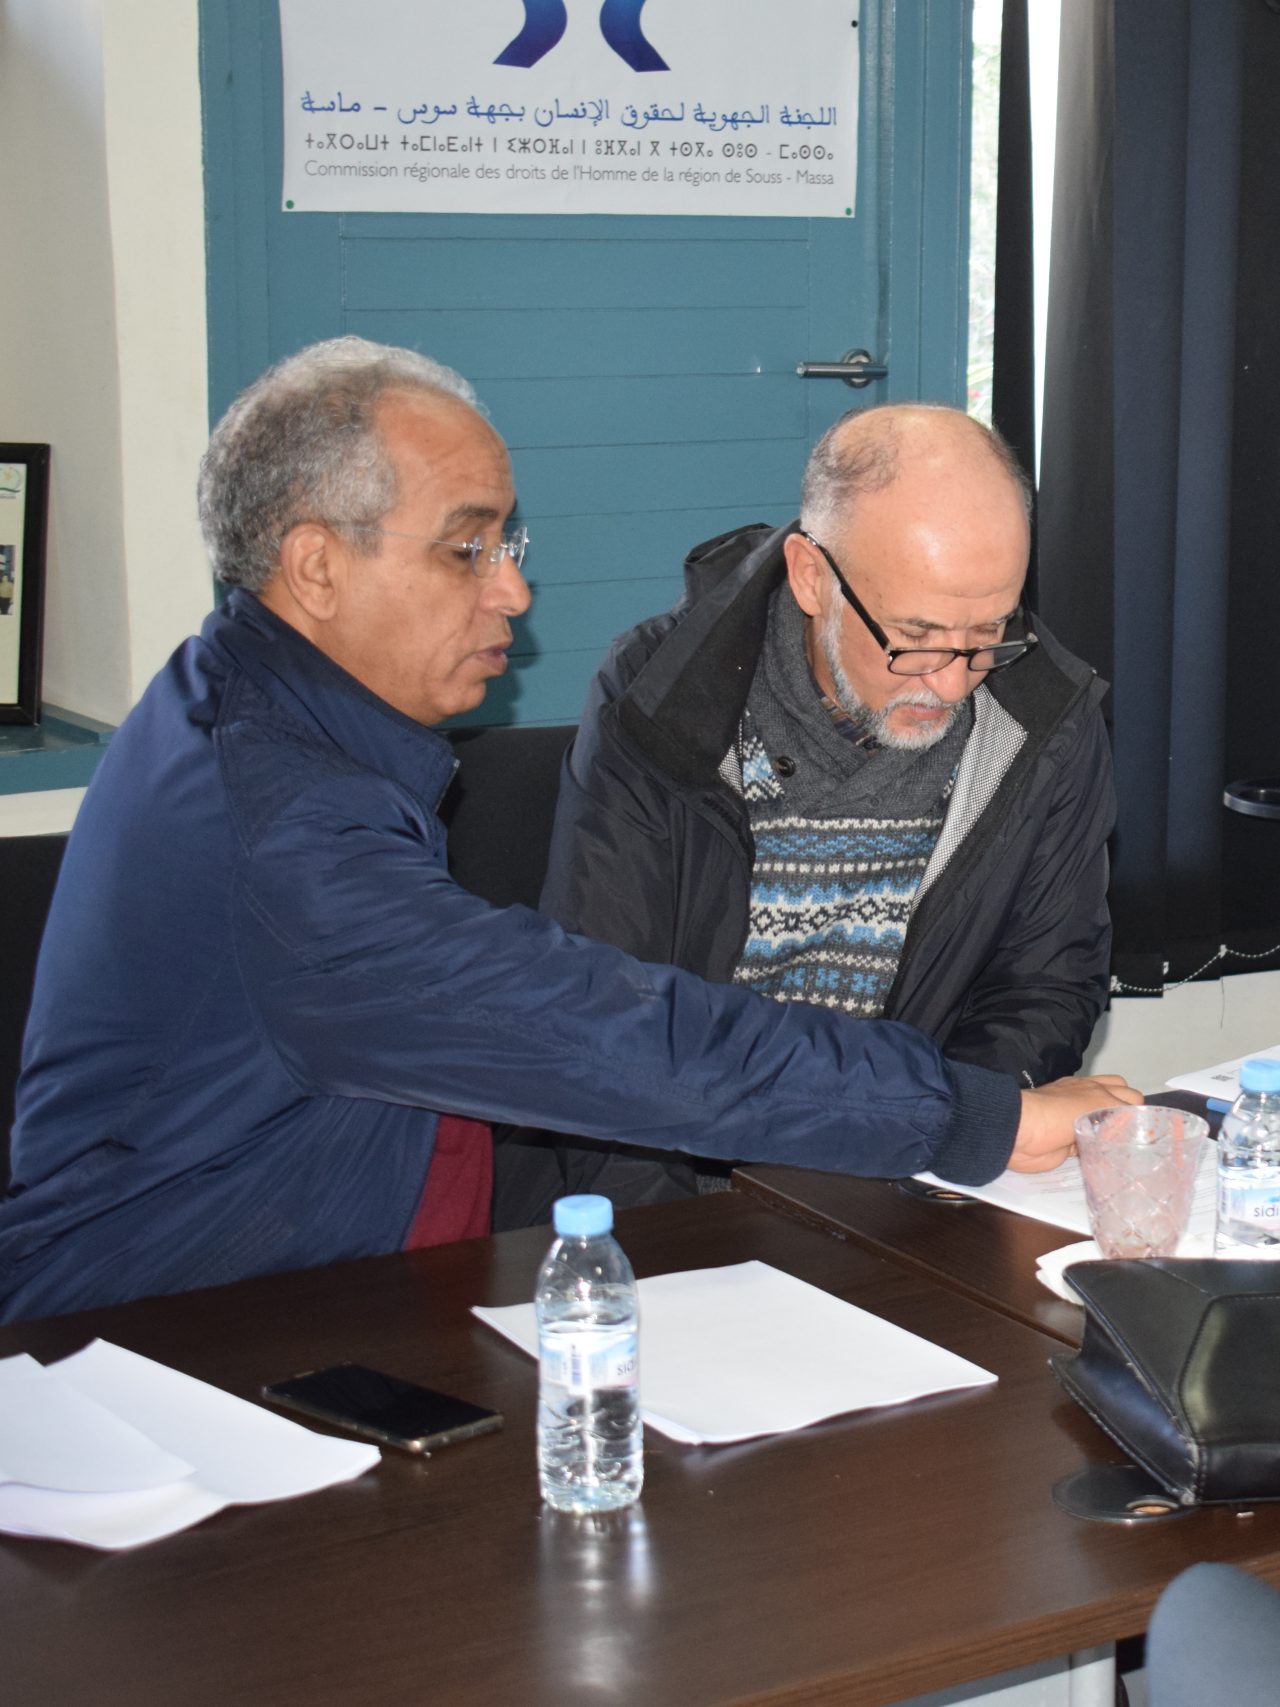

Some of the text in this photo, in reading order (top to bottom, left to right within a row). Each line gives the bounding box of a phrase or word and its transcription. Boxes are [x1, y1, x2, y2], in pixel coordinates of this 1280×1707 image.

[301, 90, 362, 114] ماسة
[396, 103, 458, 125] سوس
[466, 95, 526, 125] بجهة
[534, 97, 611, 128] الإنسان
[620, 101, 685, 130] لحقوق
[692, 102, 770, 132] الجهوية
[779, 105, 838, 130] اللجنة
[304, 159, 398, 177] Commission
[403, 161, 471, 183] régionale
[474, 164, 501, 180] des
[505, 164, 546, 180] droits
[551, 165, 569, 181] de
[573, 164, 638, 182] l'Homme
[641, 166, 659, 182] de
[663, 167, 675, 182] la
[678, 166, 721, 187] région
[724, 168, 742, 184] de
[745, 168, 783, 185] Souss
[796, 169, 835, 185] Massa
